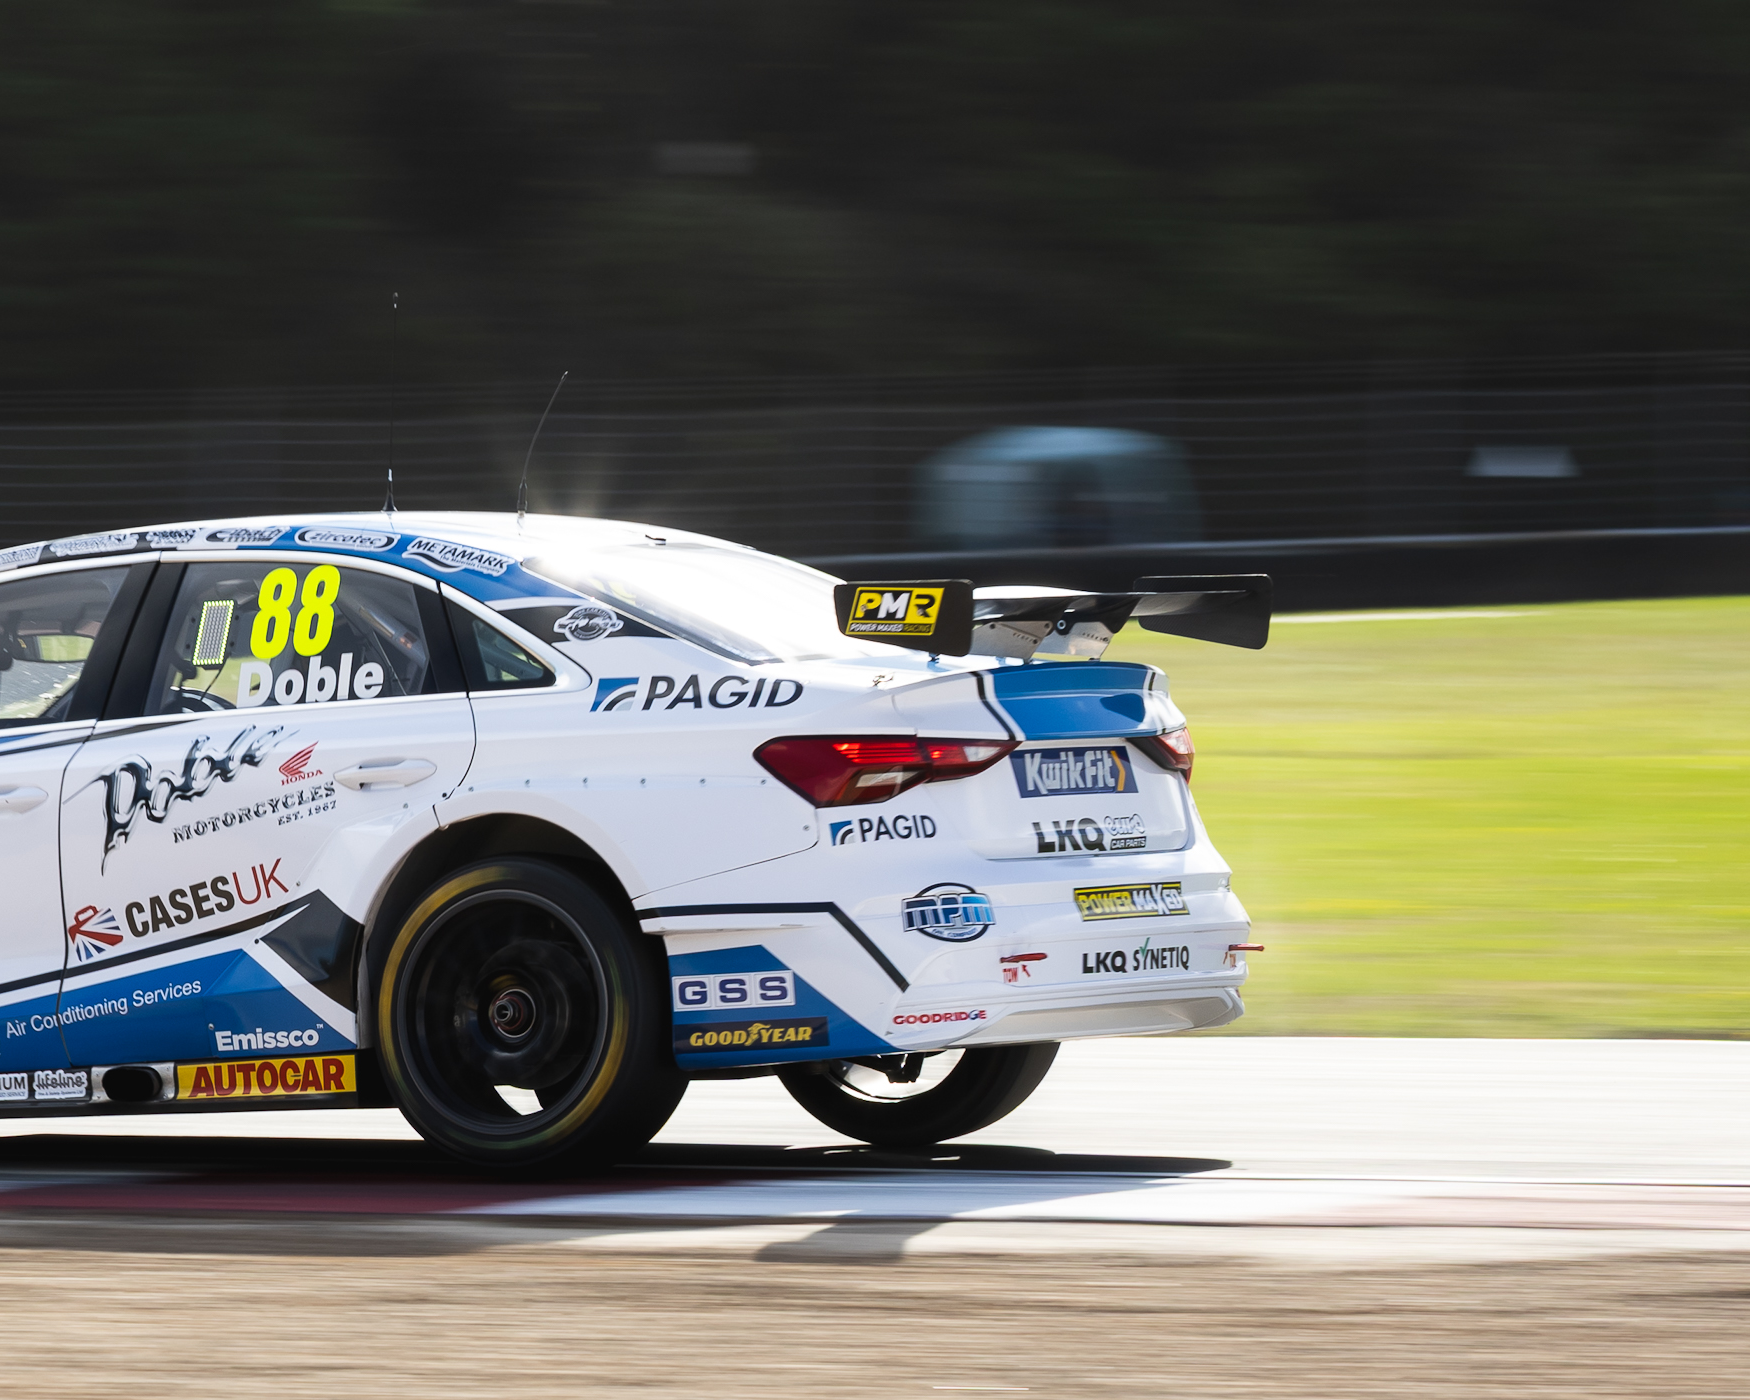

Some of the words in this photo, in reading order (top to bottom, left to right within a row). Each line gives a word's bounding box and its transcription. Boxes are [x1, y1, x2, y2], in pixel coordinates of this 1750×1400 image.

[310, 531, 381, 545] zircotec
[411, 540, 509, 569] METAMARK
[250, 564, 341, 659] 88
[854, 592, 936, 619] PMR
[236, 652, 384, 709] Doble
[641, 674, 804, 711] PAGID
[281, 769, 324, 786] HONDA
[171, 780, 336, 844] MOTORCYCLES
[277, 810, 304, 826] EST.
[308, 800, 337, 817] 1967
[858, 814, 937, 842] PAGID
[1031, 818, 1108, 854] LKQ
[1111, 840, 1125, 849] CAR
[1126, 838, 1146, 848] PARTS
[1082, 951, 1127, 974] LKQ
[1133, 938, 1190, 971] SYNETIQ
[678, 976, 788, 1005] GSS
[6, 1020, 27, 1039] Air
[30, 997, 128, 1032] Conditioning
[132, 980, 202, 1008] Services
[893, 1010, 987, 1025] GOODRIDGE
[215, 1027, 320, 1051] Emissco
[36, 1072, 85, 1089] lifeline
[188, 1058, 346, 1098] AUTOCAR
